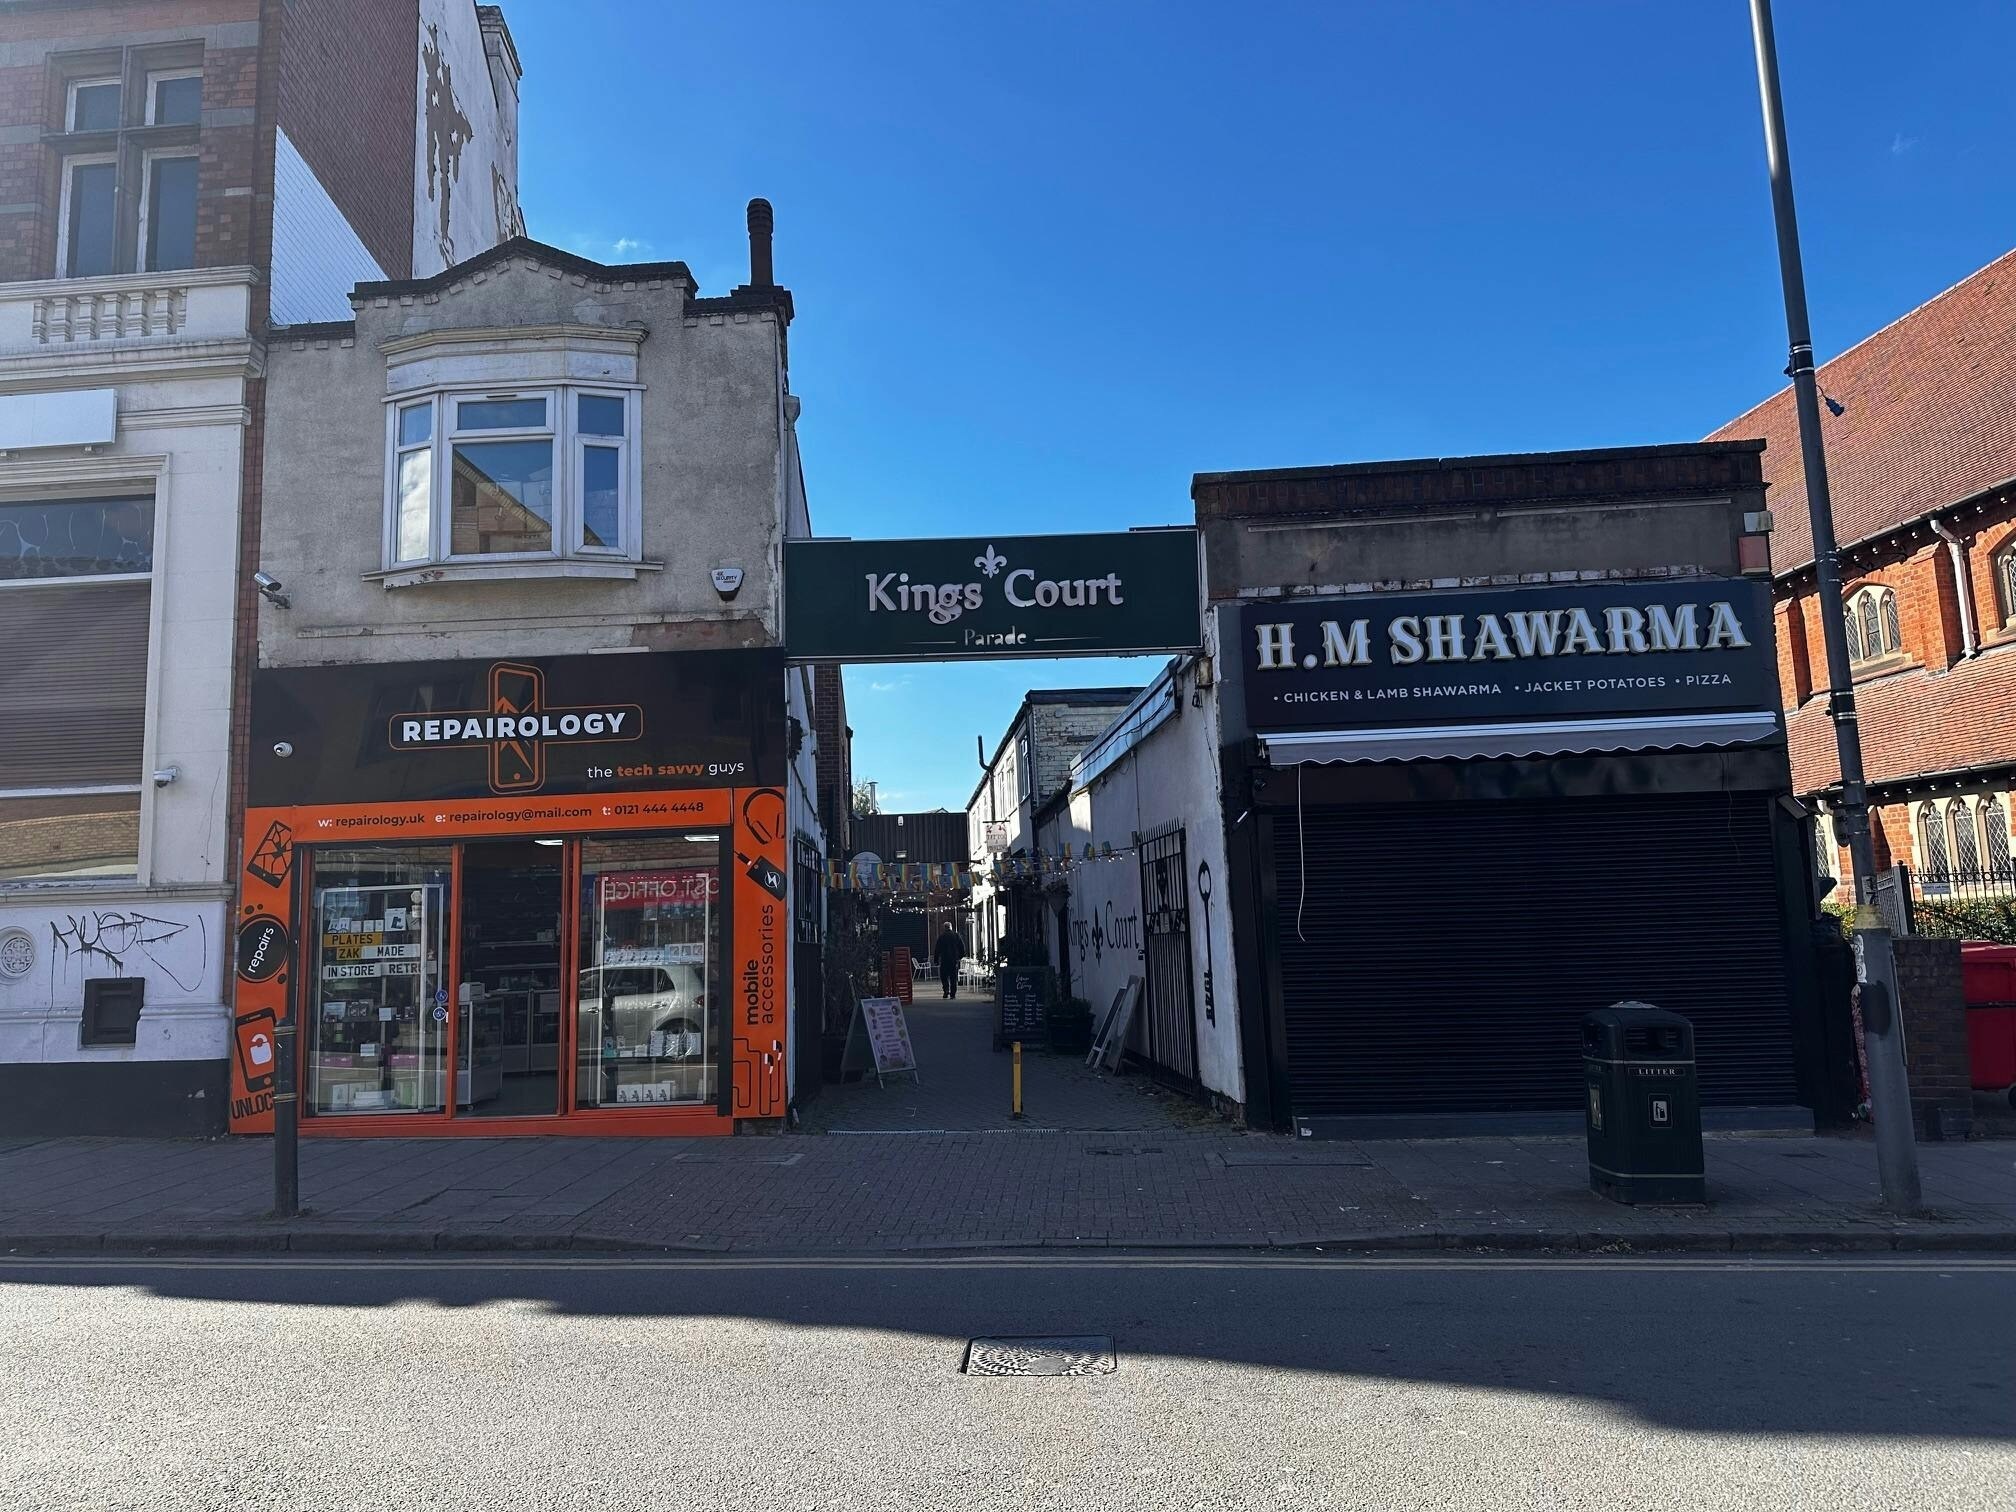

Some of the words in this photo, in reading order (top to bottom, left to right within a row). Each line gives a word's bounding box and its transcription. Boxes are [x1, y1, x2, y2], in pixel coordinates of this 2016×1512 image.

[866, 573, 983, 624] Kings
[1004, 569, 1123, 607] Court
[964, 626, 1027, 646] Parade
[1255, 619, 1372, 671] H.M
[1388, 601, 1751, 665] SHAWARMA
[1284, 691, 1349, 703] CHICKEN
[1354, 689, 1363, 699] &
[1367, 688, 1408, 699] LAMB
[1413, 684, 1501, 698] SHAWARMA
[1524, 681, 1582, 693] JACKET
[1587, 677, 1666, 690] POTATOES
[1687, 674, 1732, 686] PIZZA
[402, 712, 626, 742] REPAIROLOGY
[587, 766, 613, 778] the
[617, 764, 653, 776] tech
[658, 764, 704, 776] savvy
[708, 762, 745, 775] guys
[318, 818, 333, 827] w:
[336, 813, 425, 828] repairology.uk
[435, 813, 446, 822] e:
[450, 807, 592, 823] repairology@mail.com
[602, 806, 611, 816] t:
[614, 805, 639, 815] 0121
[643, 803, 668, 813] 444
[671, 802, 704, 813] 4448
[1105, 900, 1139, 949] Court
[248, 928, 274, 973] repairs
[332, 934, 373, 945] PLATES
[339, 948, 360, 958] ZAK
[377, 946, 405, 957] MADE
[328, 967, 338, 977] IN
[341, 965, 375, 976] STORE
[759, 904, 774, 1025] accessories
[743, 960, 759, 1025] mobile
[231, 1092, 274, 1119] UNLOC
